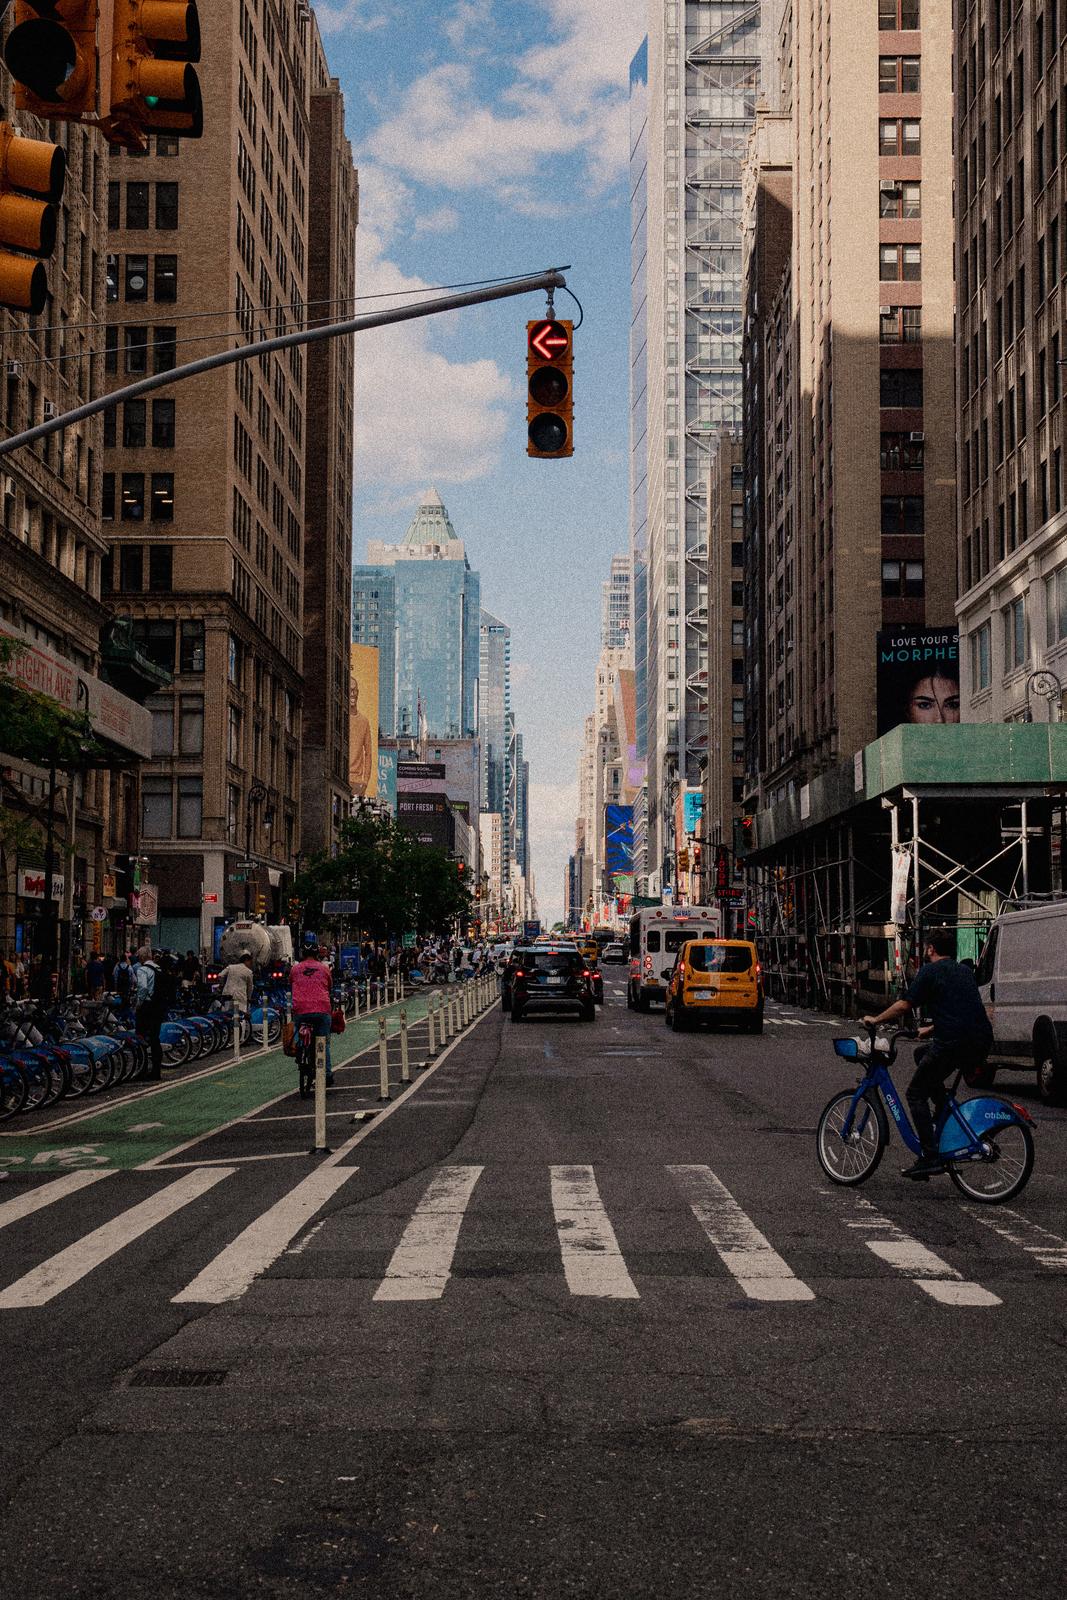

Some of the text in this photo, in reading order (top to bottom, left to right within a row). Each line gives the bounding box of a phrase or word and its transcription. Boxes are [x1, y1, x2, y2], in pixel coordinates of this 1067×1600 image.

[891, 637, 917, 647] LOVE
[920, 635, 949, 645] YOUR
[881, 646, 957, 663] MORPHE
[15, 655, 53, 694] EIGHTH
[55, 673, 72, 704] AVE
[399, 802, 415, 811] PORT
[416, 803, 434, 812] FRESH
[718, 847, 726, 886] LIQUOR
[717, 889, 742, 898] STORE
